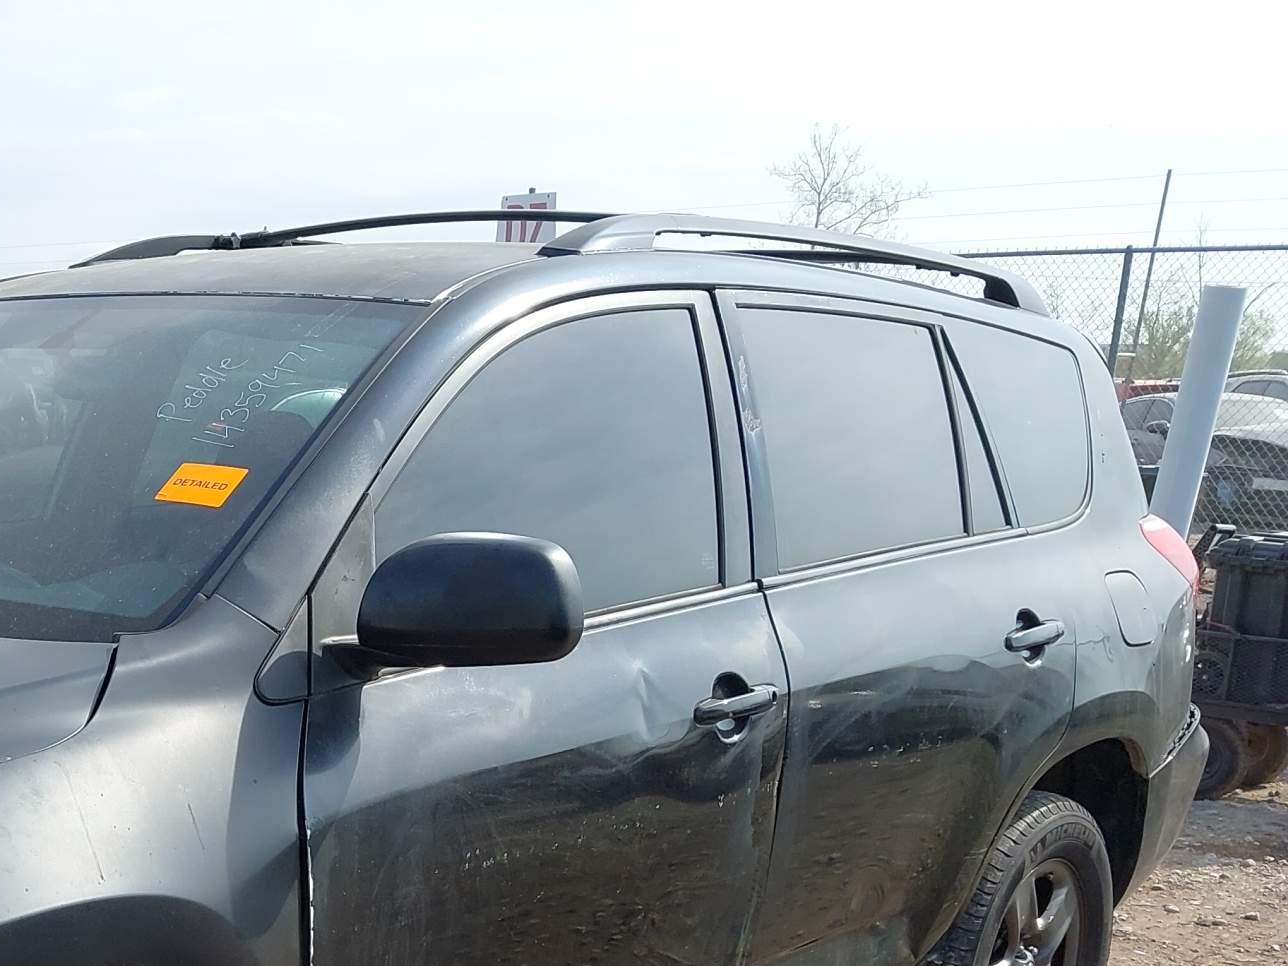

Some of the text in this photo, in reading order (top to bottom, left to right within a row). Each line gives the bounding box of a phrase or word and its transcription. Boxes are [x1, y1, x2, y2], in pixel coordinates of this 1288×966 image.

[157, 358, 249, 423] Peddle
[192, 343, 324, 447] 14359471
[172, 478, 228, 491] DETAILED
[1046, 823, 1097, 849] MICHELIN
